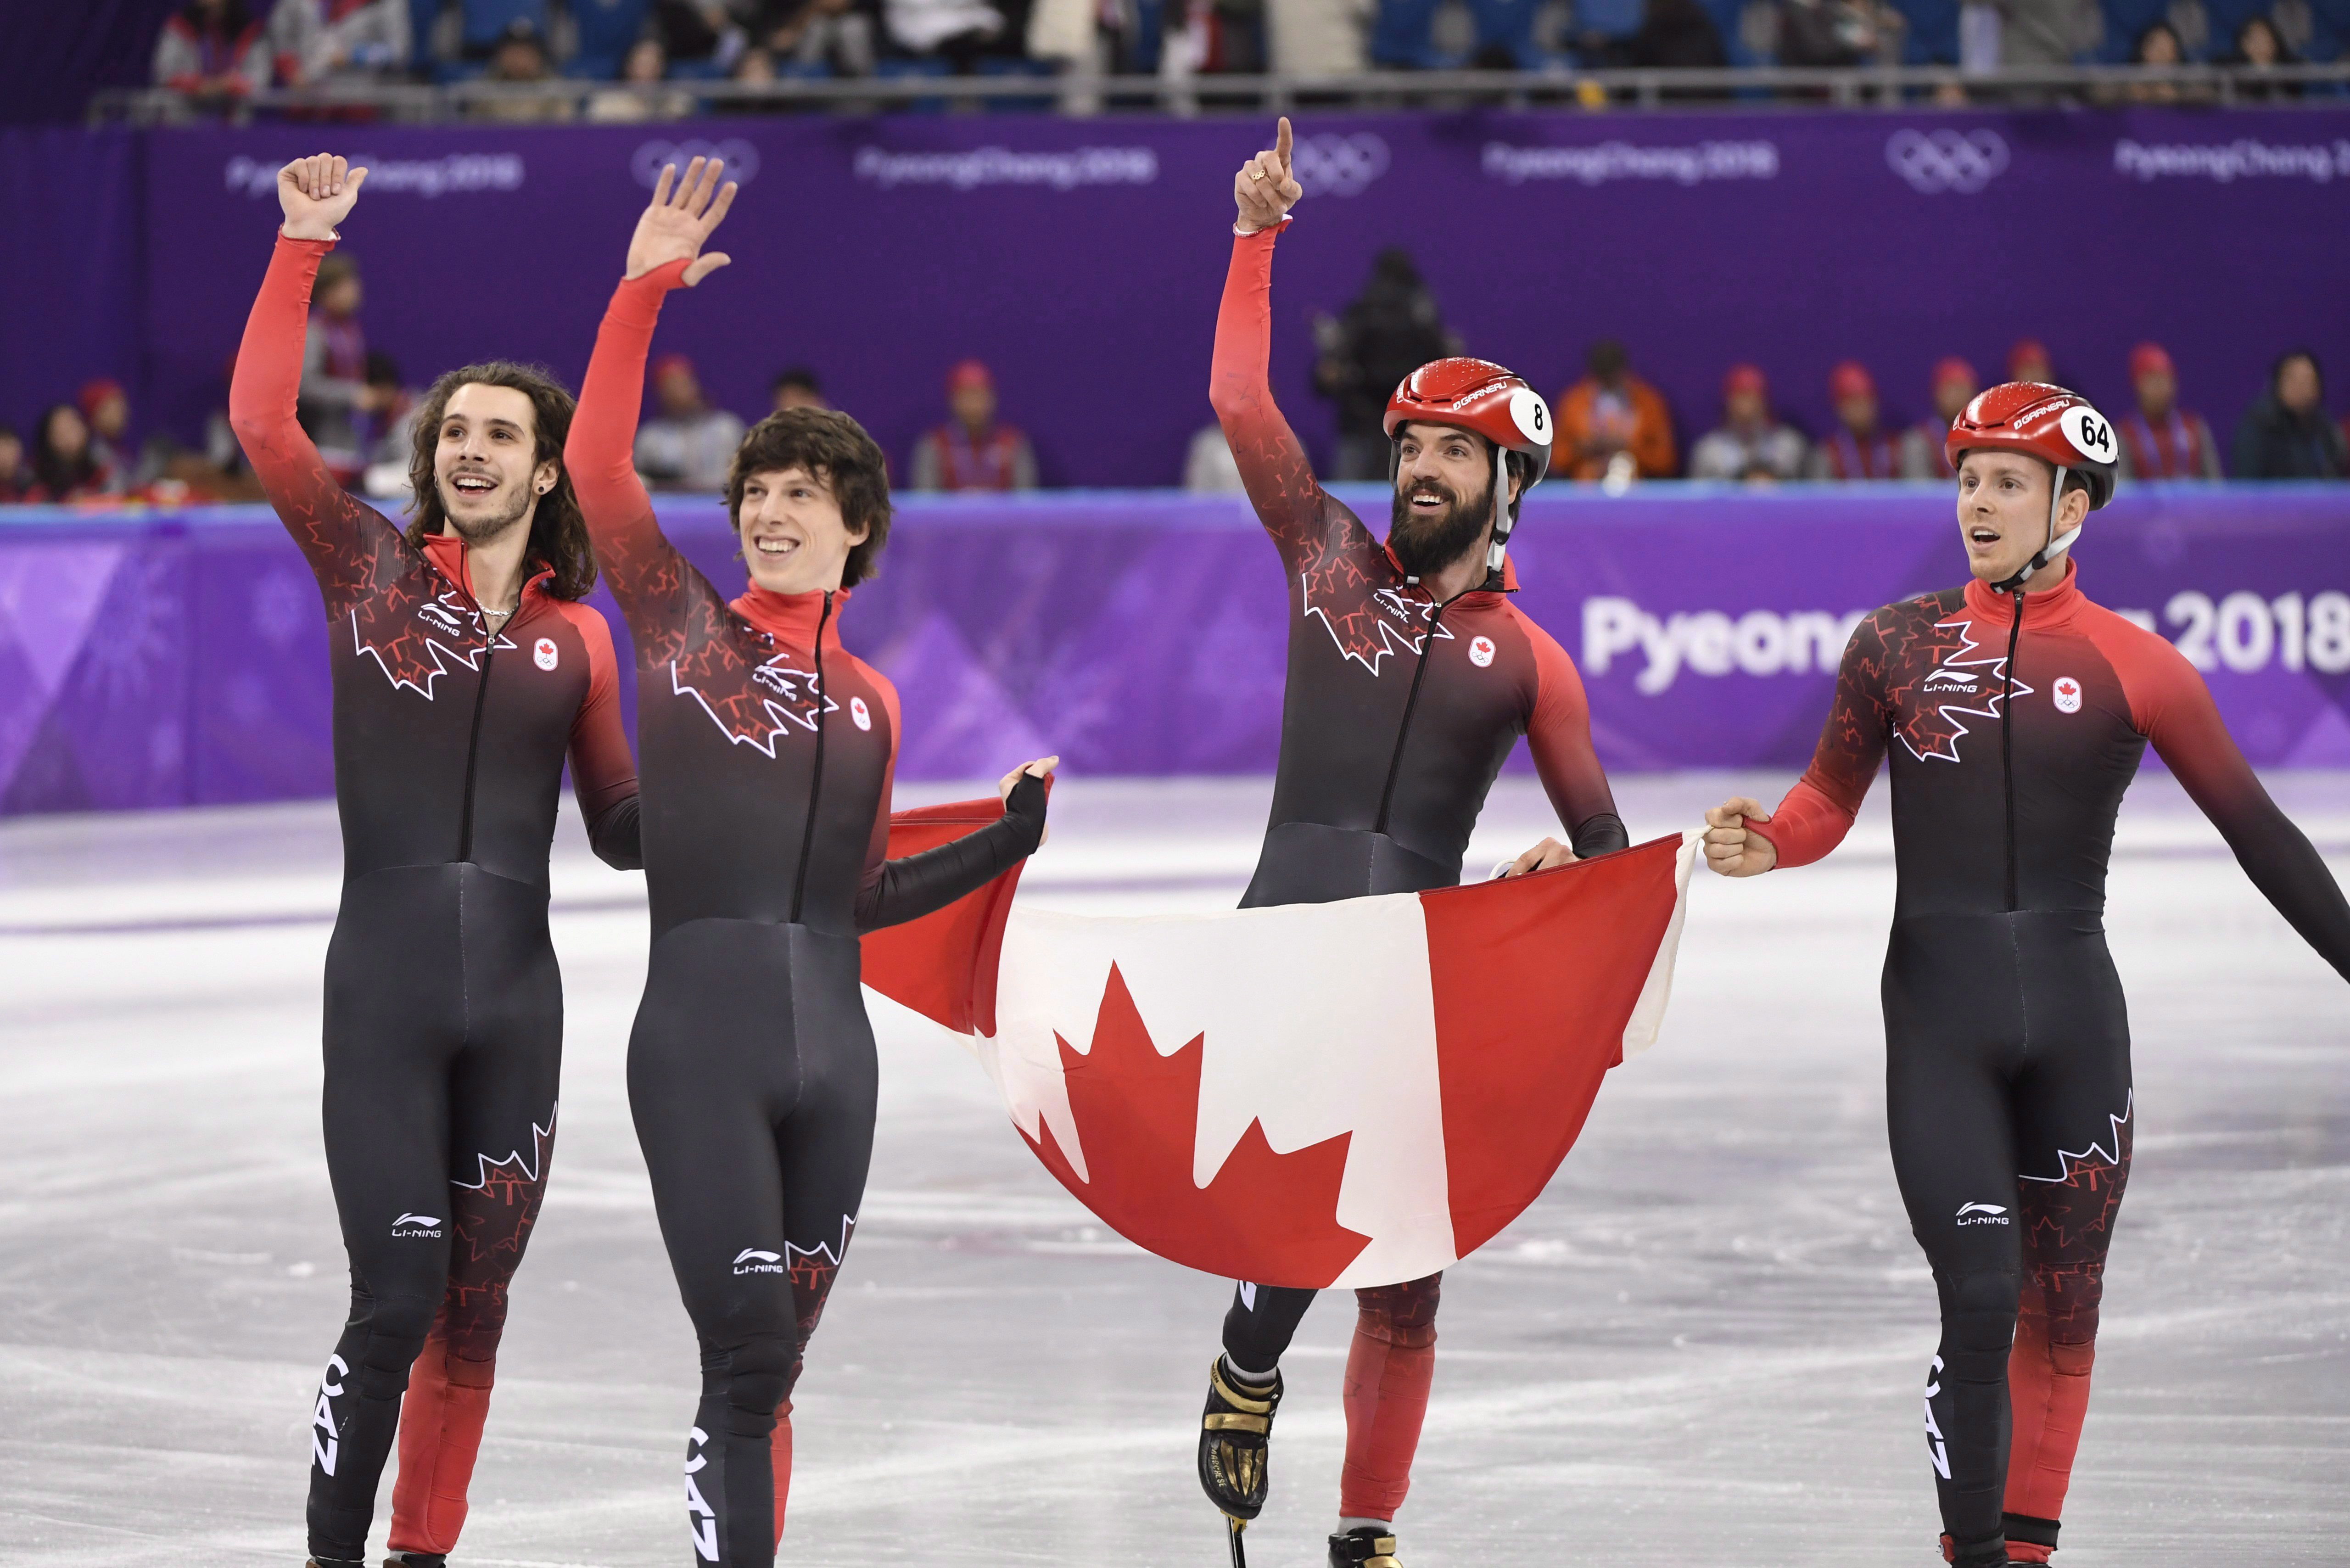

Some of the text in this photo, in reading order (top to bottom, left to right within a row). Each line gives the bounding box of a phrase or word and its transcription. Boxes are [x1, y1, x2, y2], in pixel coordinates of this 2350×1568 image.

[1460, 381, 1507, 406] GARNEAU
[1534, 403, 1544, 431] 8
[2022, 399, 2070, 425] GARNEAU
[2081, 415, 2109, 453] 64
[418, 610, 460, 637] LI-NING
[2165, 589, 2350, 673] 2018
[1923, 683, 1978, 693] LI-NING
[392, 1228, 442, 1238] LI-NING
[1957, 1216, 2009, 1226] LI-NING
[733, 1265, 783, 1275] LI-NING
[312, 1354, 349, 1477] CAN
